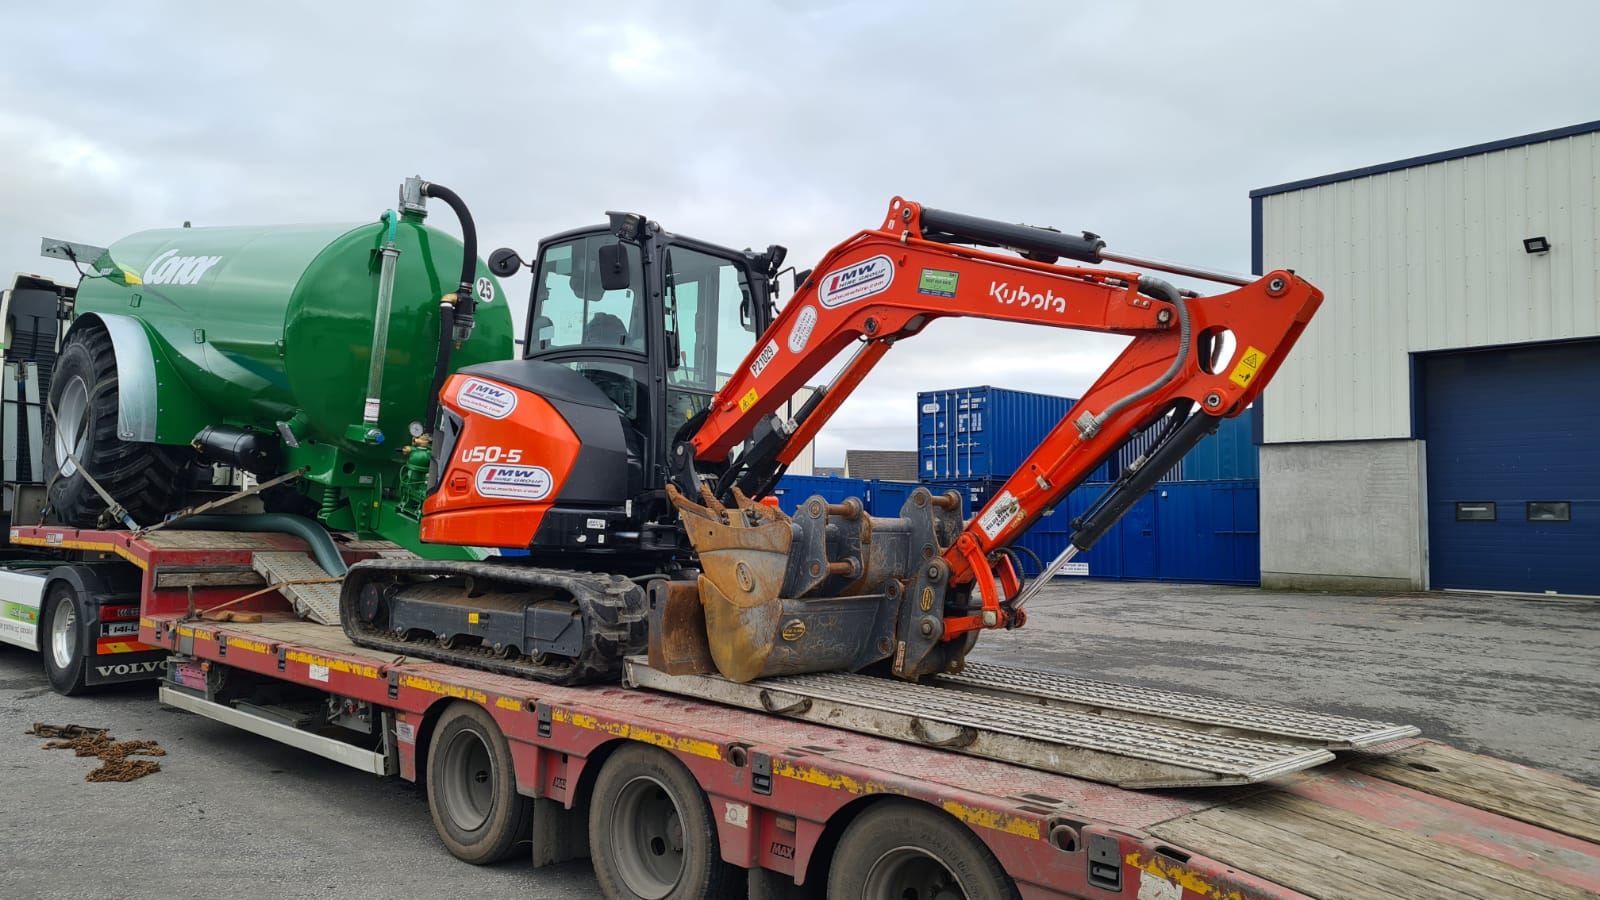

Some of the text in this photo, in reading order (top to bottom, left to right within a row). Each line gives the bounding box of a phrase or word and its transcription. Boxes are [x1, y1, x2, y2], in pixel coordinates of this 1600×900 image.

[143, 249, 223, 285] Conor
[479, 279, 492, 300] 25
[989, 281, 1066, 313] Kubota
[751, 345, 775, 376] P21029
[771, 843, 795, 860] MAX
